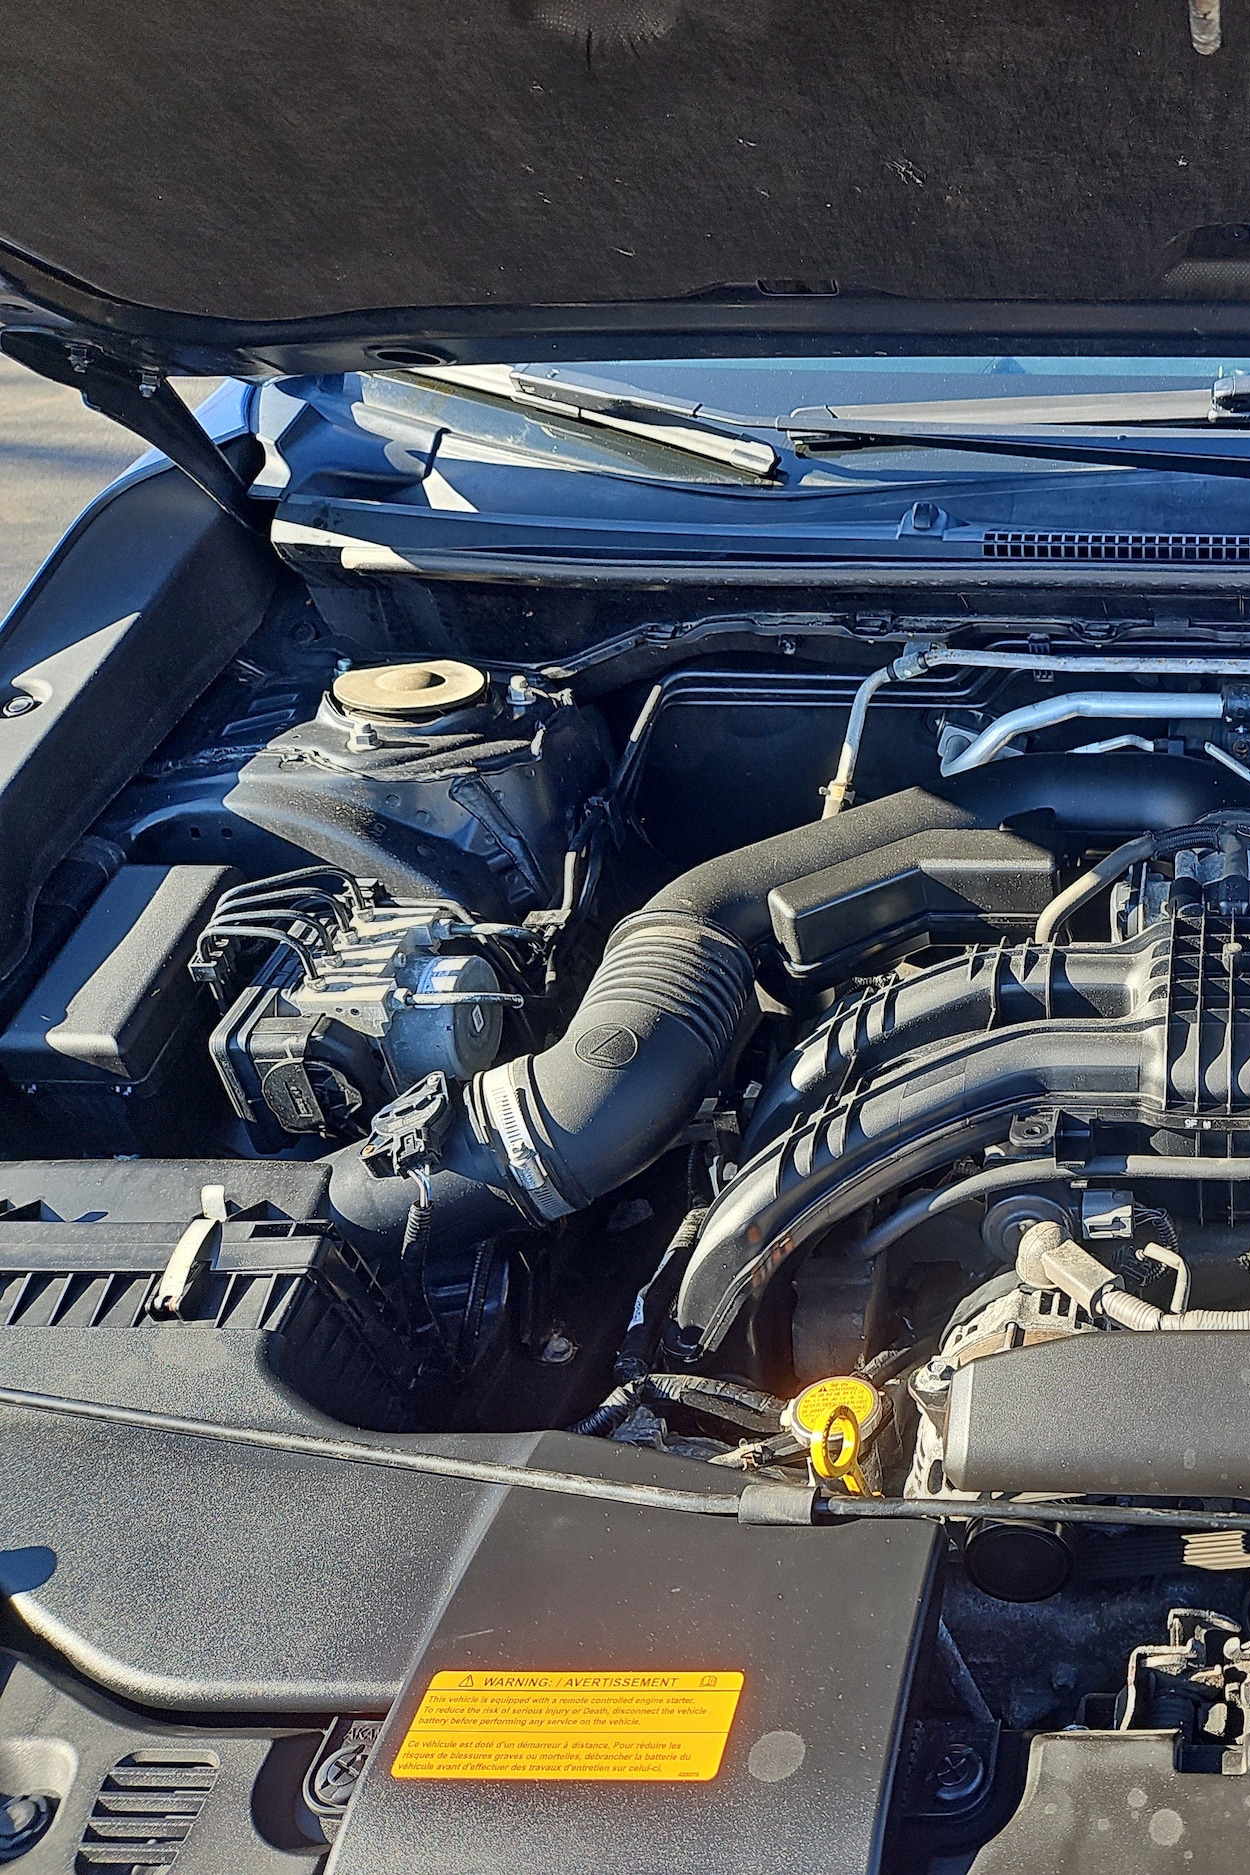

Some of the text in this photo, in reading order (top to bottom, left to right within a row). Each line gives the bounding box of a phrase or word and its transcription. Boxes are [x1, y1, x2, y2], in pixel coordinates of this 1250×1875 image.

[483, 1677, 553, 1687] WARNING:
[563, 1677, 679, 1687] AVERTISSEMENT
[429, 1695, 446, 1703] This
[490, 1696, 530, 1706] equipped
[635, 1697, 664, 1706] engine
[435, 1706, 465, 1714] reduce
[467, 1706, 481, 1714] the
[583, 1707, 610, 1716] Death,
[612, 1707, 660, 1715] disconnect
[418, 1717, 449, 1727] battery
[479, 1718, 527, 1727] performing
[528, 1719, 545, 1727] any
[608, 1718, 641, 1726] vehicle.
[343, 1726, 382, 1740] AKA
[407, 1740, 420, 1748] Ce
[422, 1740, 457, 1748] véhicule
[474, 1740, 493, 1748] doté
[496, 1741, 515, 1749] d'un
[516, 1741, 562, 1749] démarreur
[562, 1741, 568, 1749] à
[571, 1741, 610, 1749] distance.
[635, 1741, 667, 1749] réduire
[402, 1752, 435, 1760] risques
[539, 1752, 582, 1761] mortelles,
[584, 1752, 634, 1761] débrancher
[634, 1753, 642, 1761] la
[644, 1753, 678, 1761] batterie
[679, 1753, 691, 1761] du
[398, 1762, 435, 1770] véhicule
[462, 1763, 509, 1771] d'effectuer
[510, 1763, 527, 1771] des
[563, 1764, 611, 1772] d'entretien
[628, 1764, 662, 1772] celui-ci.
